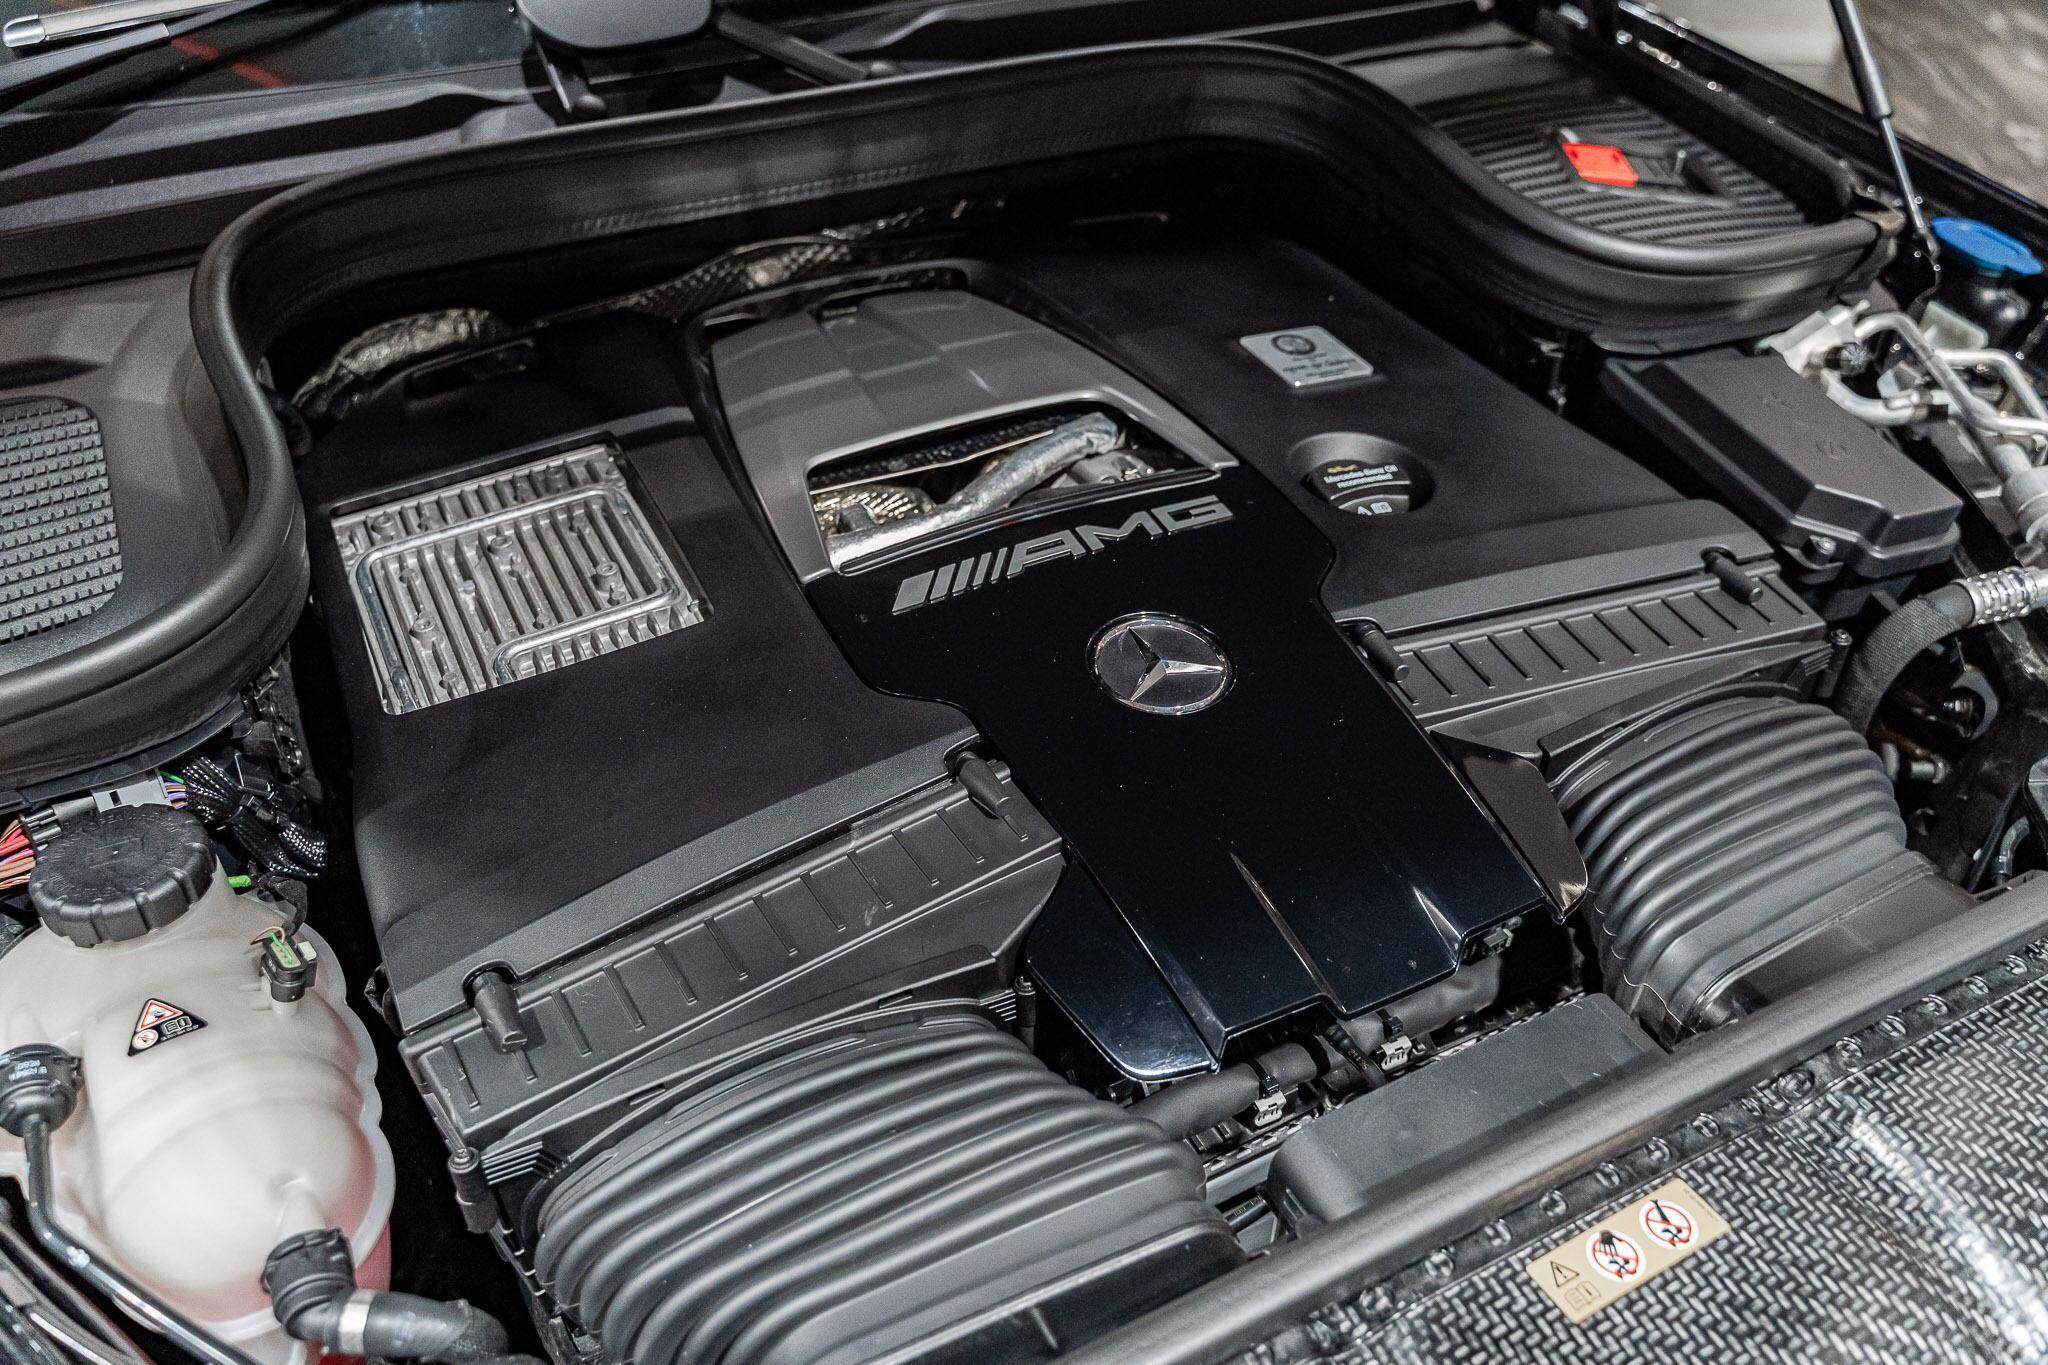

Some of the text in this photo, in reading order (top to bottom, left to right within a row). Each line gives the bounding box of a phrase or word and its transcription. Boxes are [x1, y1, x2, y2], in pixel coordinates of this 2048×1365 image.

[1323, 467, 1384, 484] Mercedes-Benz
[1336, 472, 1393, 488] recommended
[1007, 495, 1232, 578] AMG
